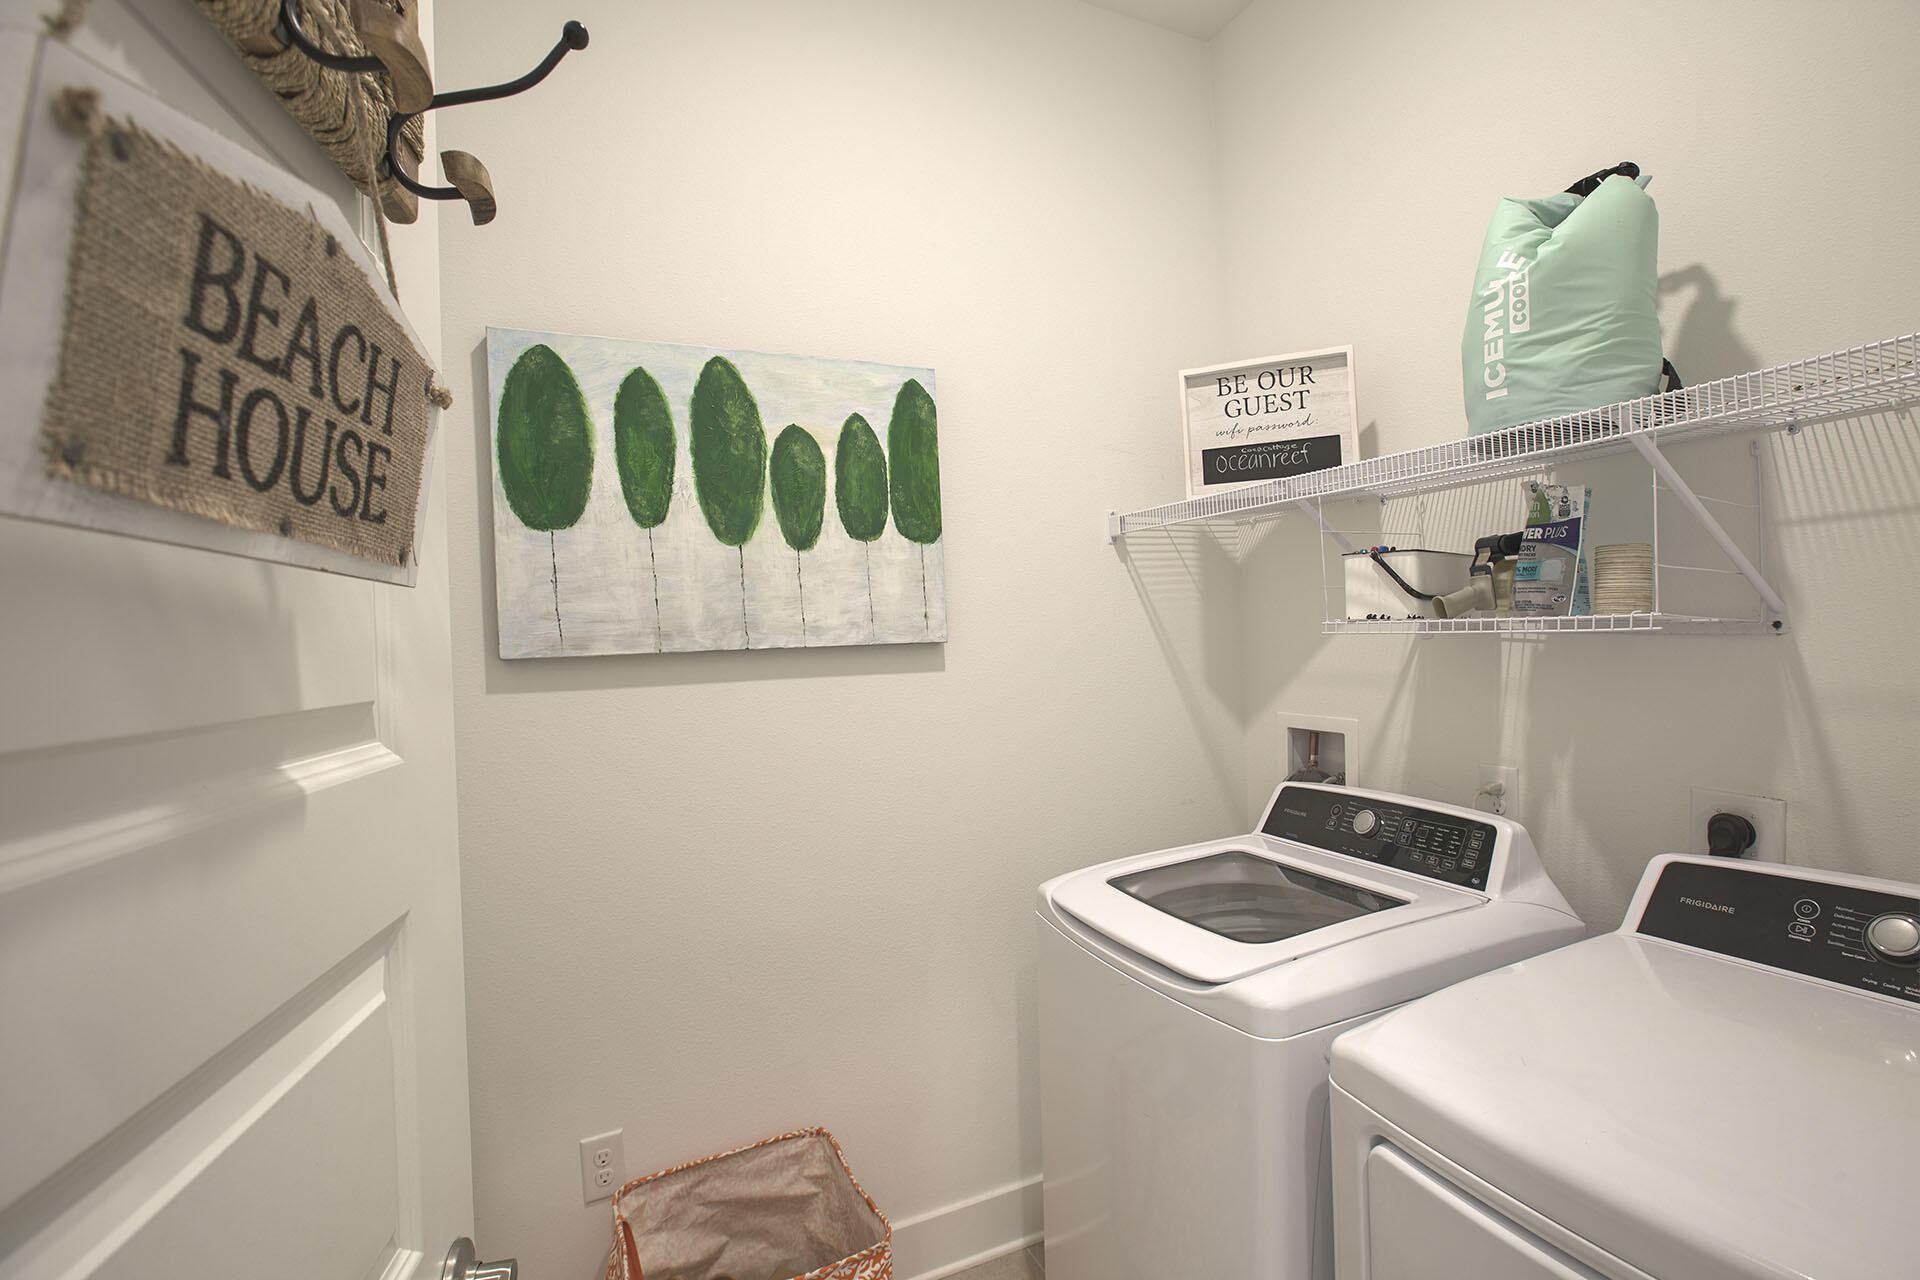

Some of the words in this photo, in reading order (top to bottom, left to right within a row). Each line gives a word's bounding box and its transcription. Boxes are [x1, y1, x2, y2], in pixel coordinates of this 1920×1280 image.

[183, 212, 400, 437] BEACH
[1216, 374, 1249, 397] BE
[1257, 365, 1316, 391] OUR
[1224, 389, 1311, 419] GUEST
[165, 347, 393, 525] HOUSE
[1215, 422, 1244, 440] wifi
[1544, 526, 1569, 539] PLUS
[1679, 896, 1736, 915] FRIGIDAIRE
